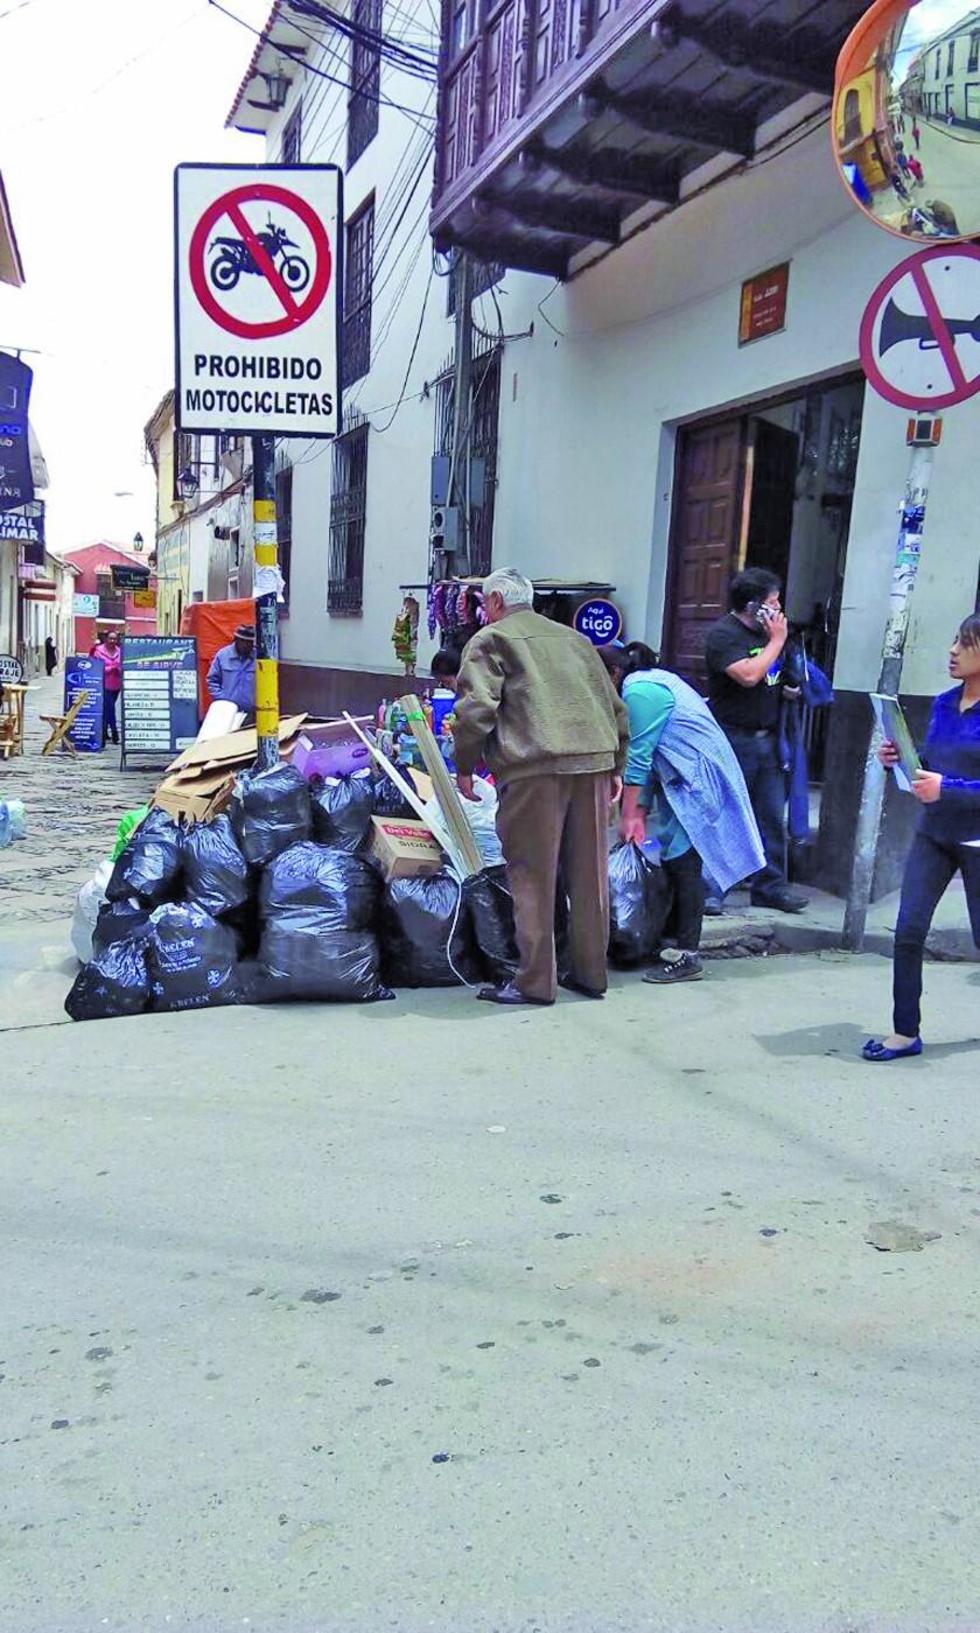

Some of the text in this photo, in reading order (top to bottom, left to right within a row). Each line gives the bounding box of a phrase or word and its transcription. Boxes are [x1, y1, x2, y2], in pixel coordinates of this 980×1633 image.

[194, 354, 322, 381] PROHIBIDO
[186, 389, 333, 416] MOTOCICLETAS
[0, 526, 39, 542] IMAR
[582, 616, 613, 631] tigo
